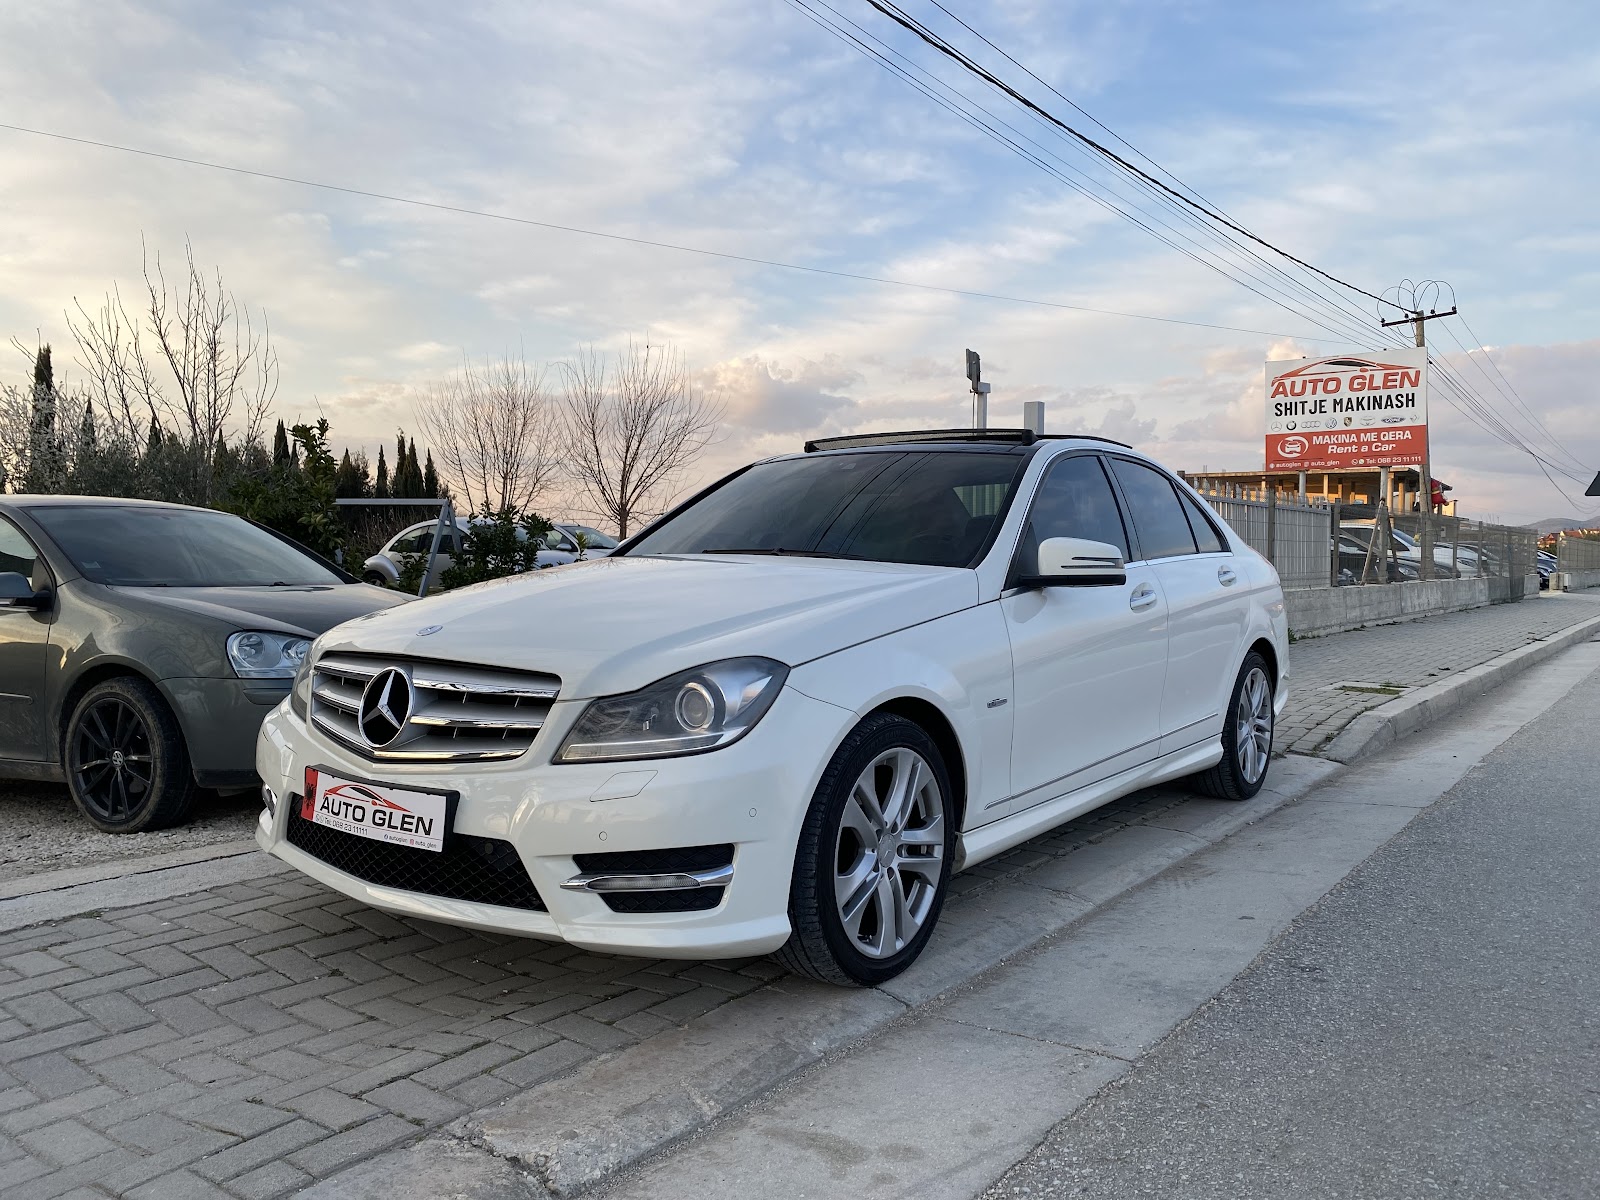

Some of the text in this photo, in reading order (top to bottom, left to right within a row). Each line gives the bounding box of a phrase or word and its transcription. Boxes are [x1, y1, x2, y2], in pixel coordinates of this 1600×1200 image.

[1270, 370, 1421, 398] AUTO GLEN
[1275, 392, 1415, 416] SHITJE MAKINASH
[1312, 430, 1412, 445] MAKINA ME QERA
[1327, 444, 1358, 454] Rent
[1371, 442, 1396, 452] Car
[320, 796, 434, 836] AUTO GLEN
